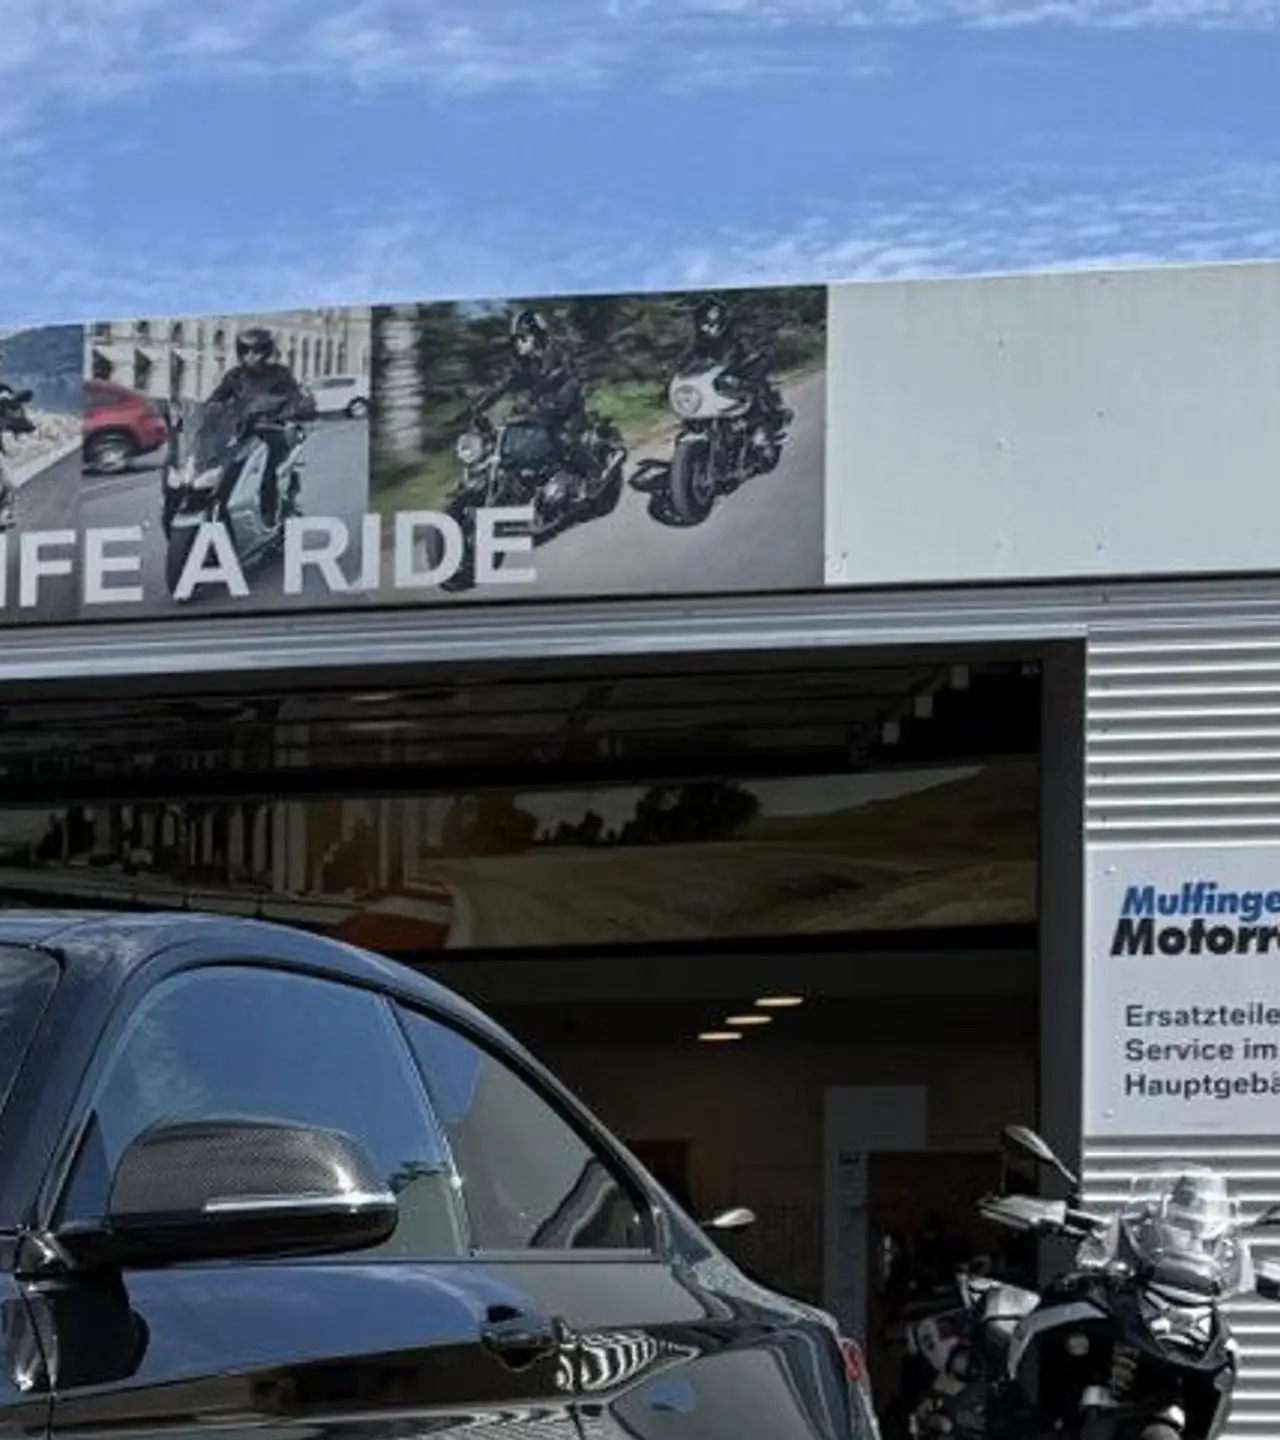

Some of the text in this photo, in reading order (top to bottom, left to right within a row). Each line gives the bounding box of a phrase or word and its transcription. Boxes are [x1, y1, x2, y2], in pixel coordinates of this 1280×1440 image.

[174, 521, 250, 602] A
[283, 506, 538, 593] RIDE
[1109, 917, 1280, 957] Motorr
[1125, 1002, 1280, 1028] Ersatzteile
[1125, 1037, 1278, 1062] Service im
